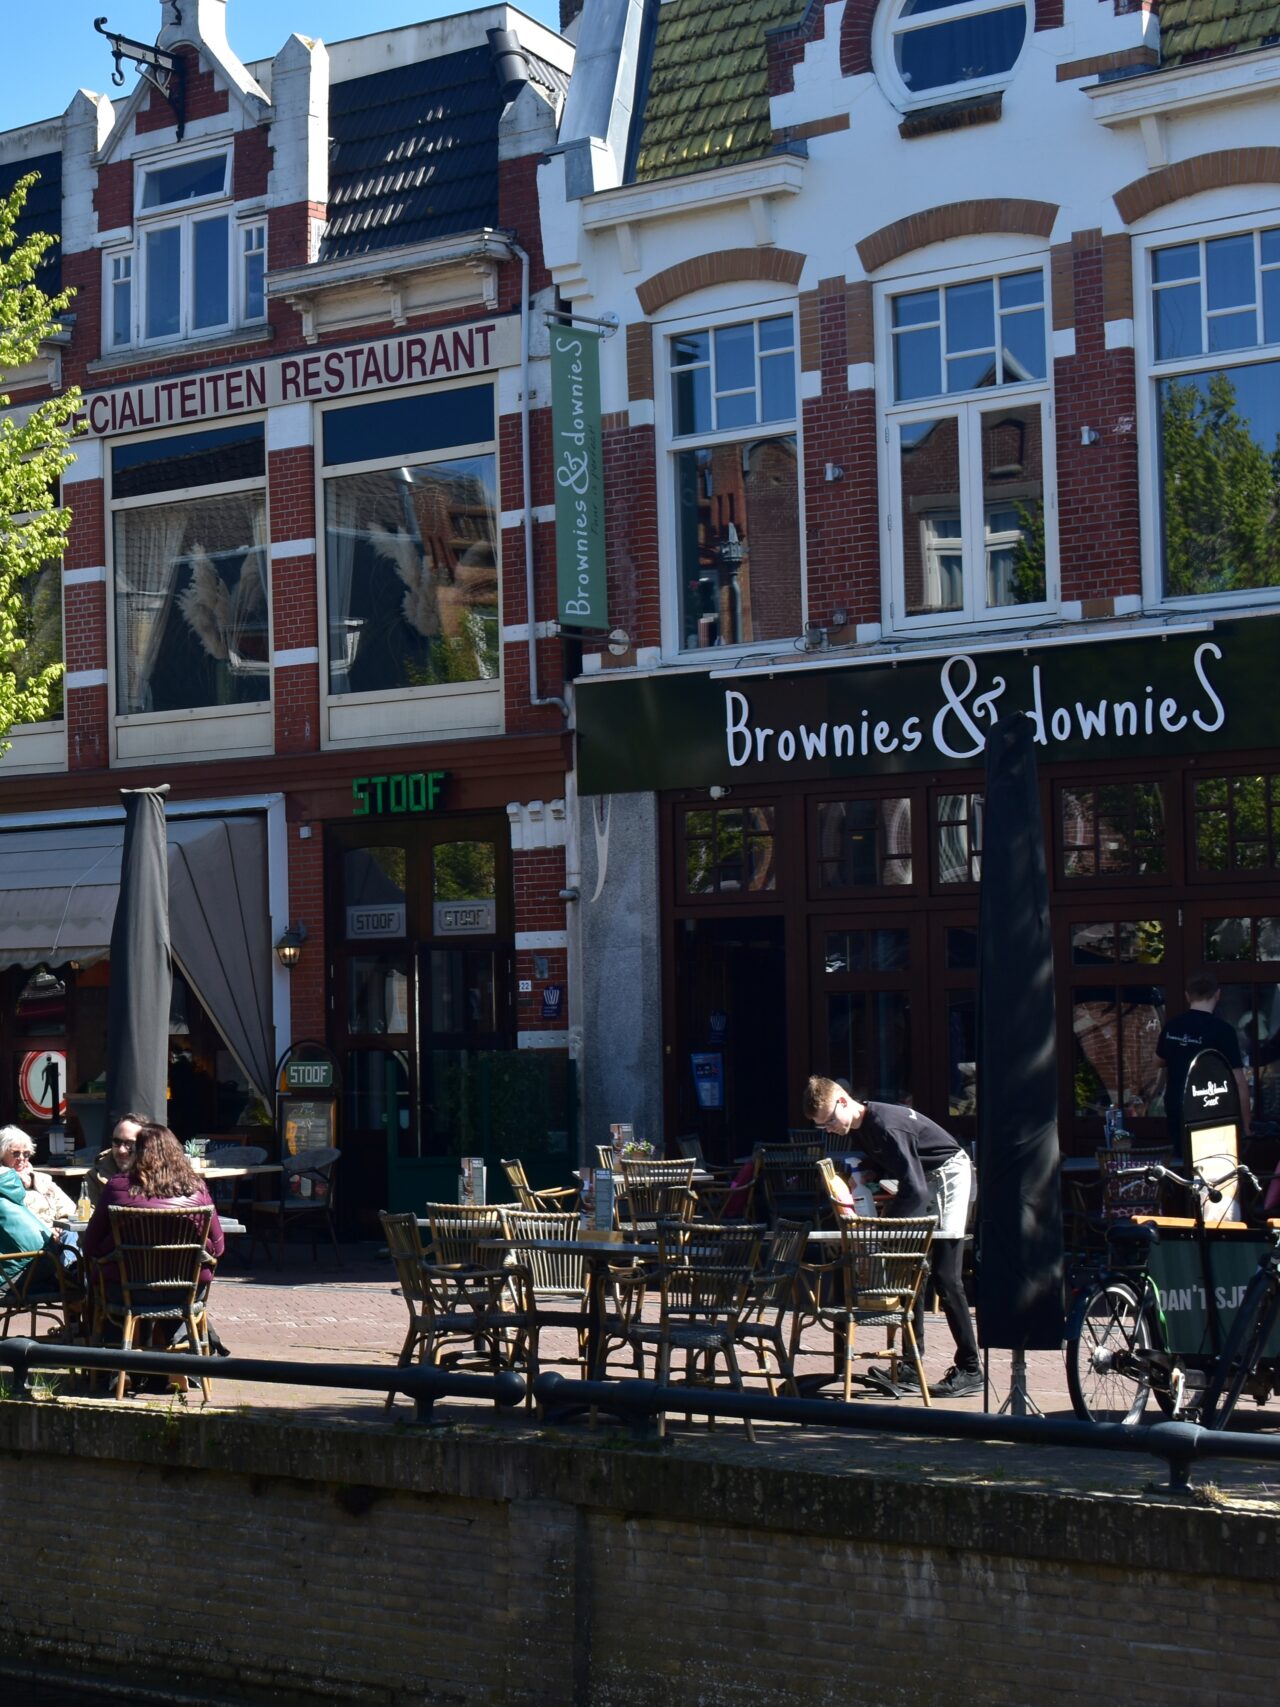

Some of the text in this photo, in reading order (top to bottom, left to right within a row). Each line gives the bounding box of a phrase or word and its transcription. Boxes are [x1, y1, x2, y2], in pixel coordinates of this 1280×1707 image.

[281, 324, 496, 399] RESTAURANT
[725, 689, 922, 767] Brownies
[352, 771, 445, 816] STOOF
[356, 913, 395, 930] STOOF
[444, 909, 484, 927] STOOF
[521, 982, 530, 990] 22
[290, 1065, 328, 1083] STOOF
